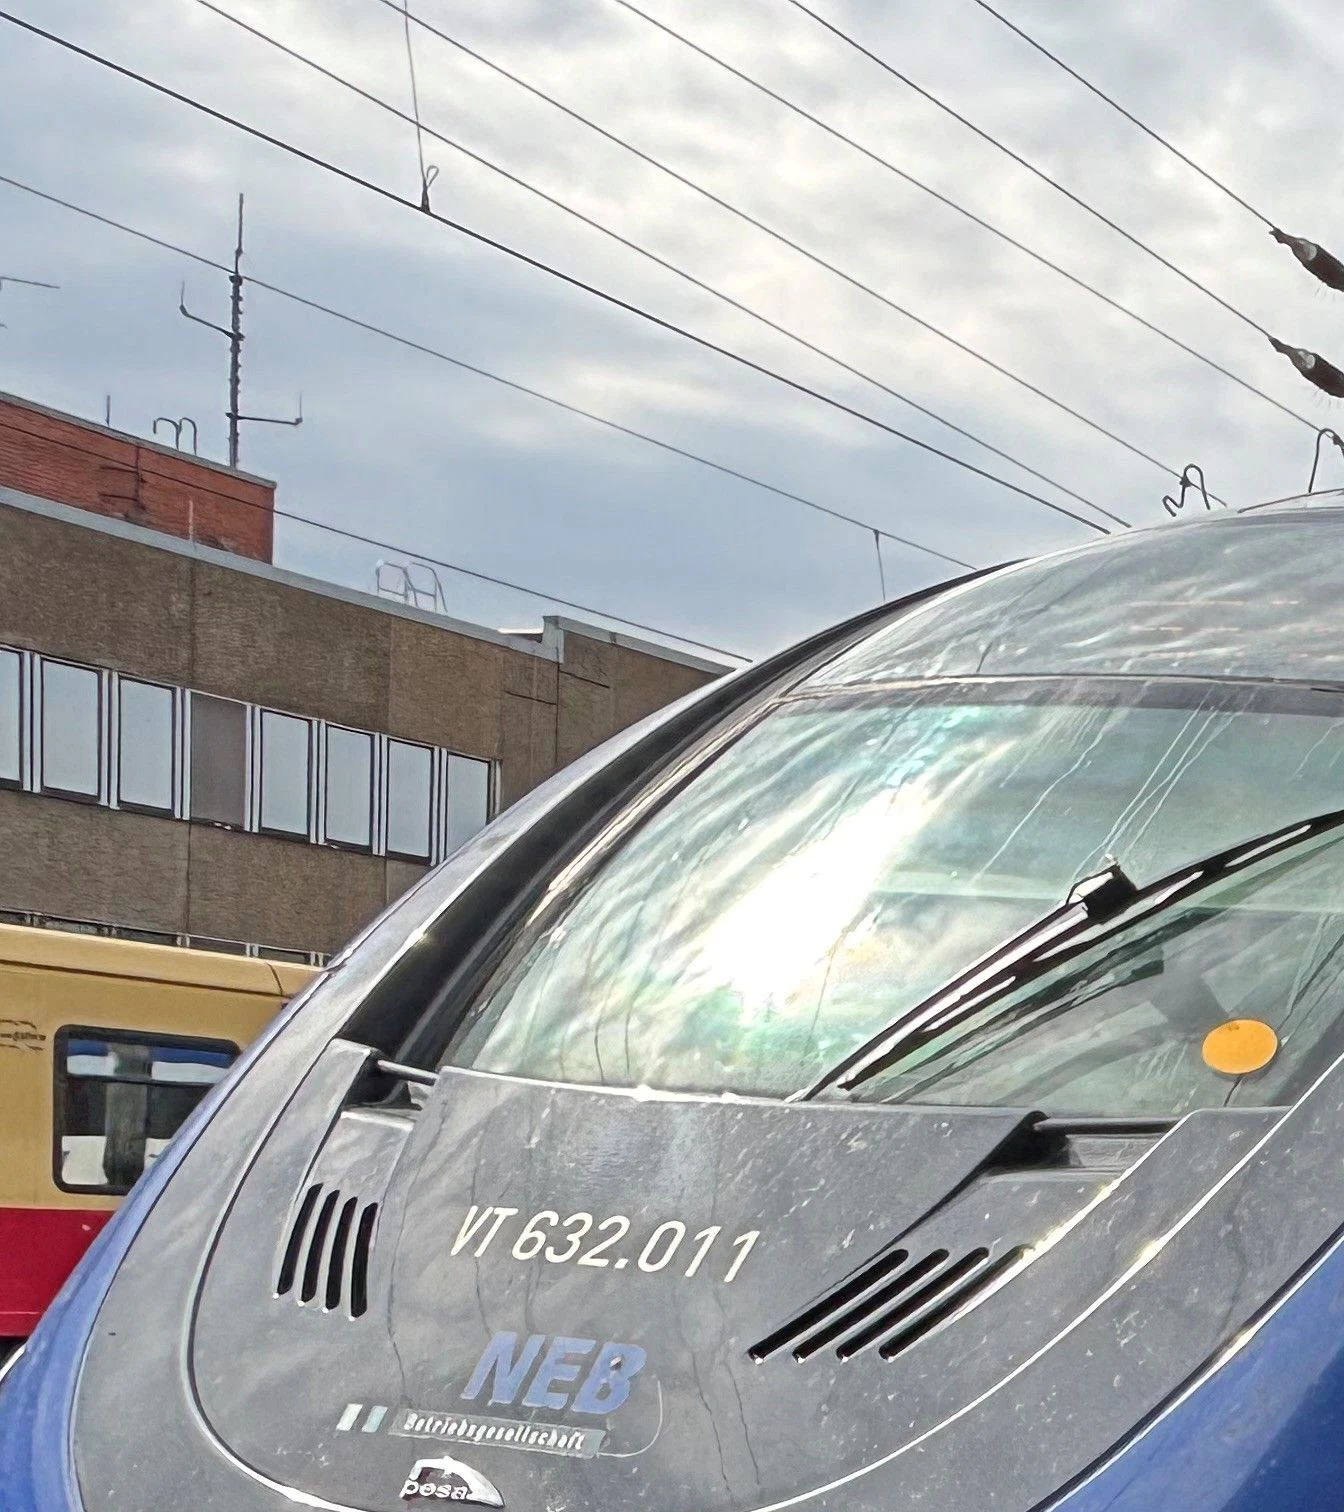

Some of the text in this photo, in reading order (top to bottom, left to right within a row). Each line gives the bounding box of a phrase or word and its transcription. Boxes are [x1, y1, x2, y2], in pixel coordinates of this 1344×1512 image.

[450, 1205, 760, 1283] VT 632.011
[459, 1331, 647, 1415] NEB
